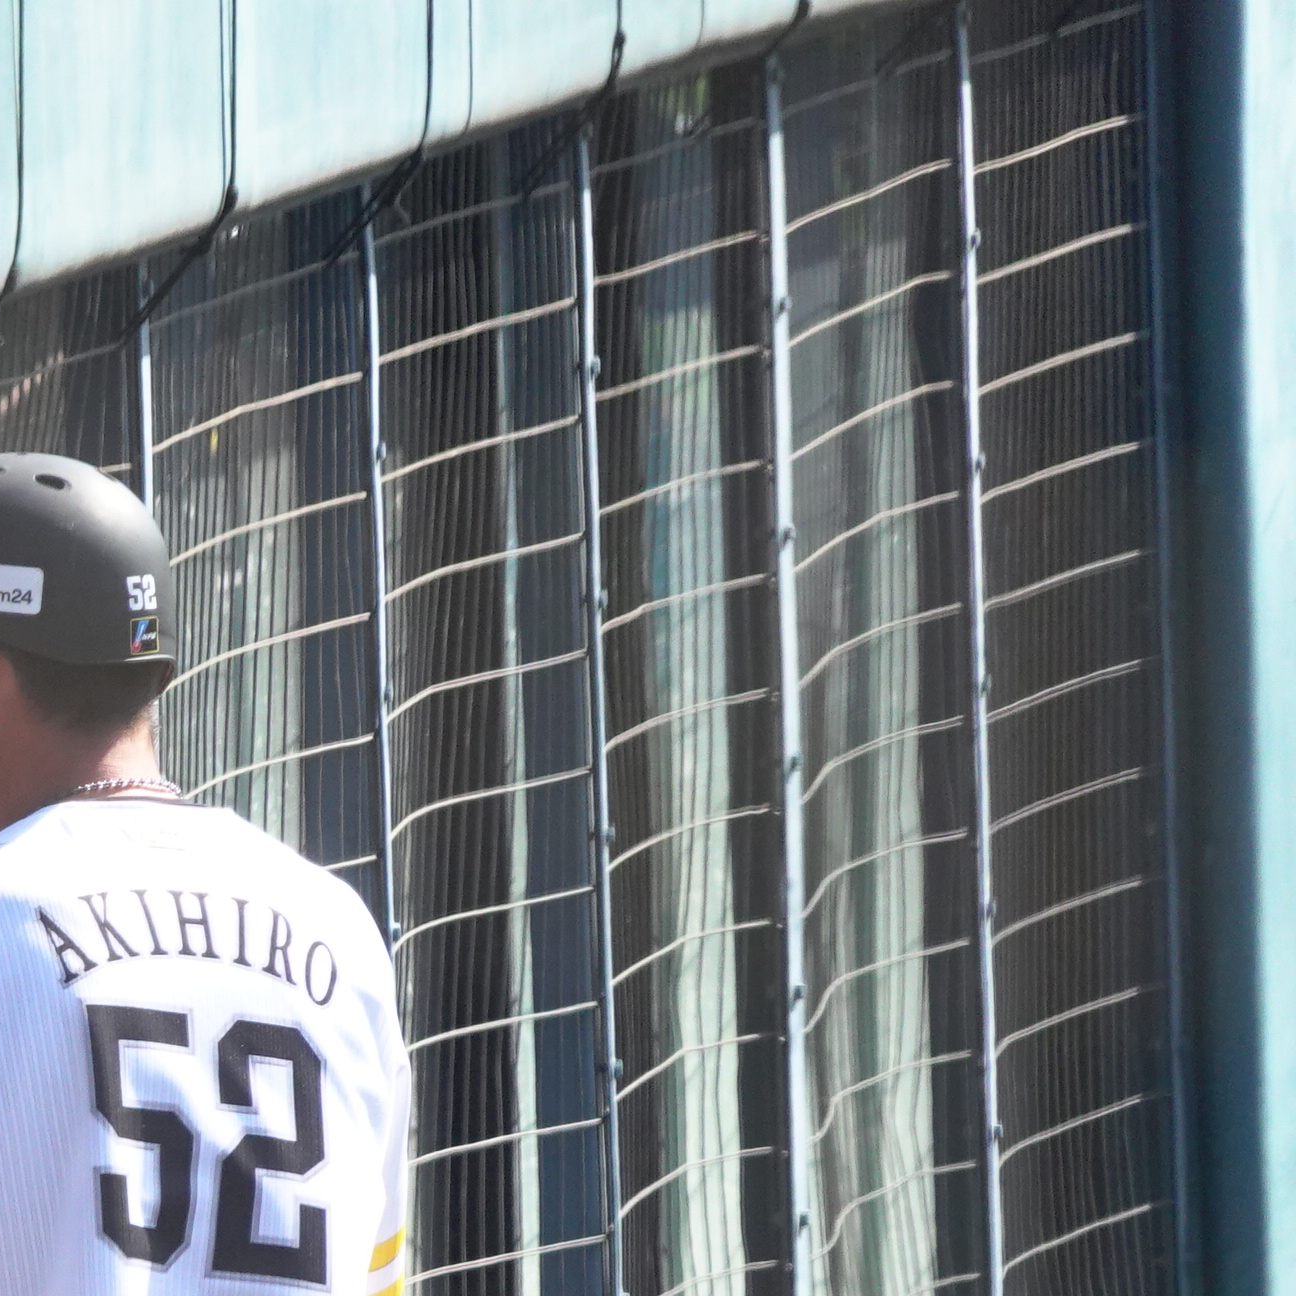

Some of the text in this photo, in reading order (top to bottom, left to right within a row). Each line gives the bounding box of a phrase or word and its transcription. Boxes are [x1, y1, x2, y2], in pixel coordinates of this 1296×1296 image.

[125, 573, 158, 612] 52
[36, 889, 338, 1007] AKIHIRO
[83, 1002, 330, 1286] 52
